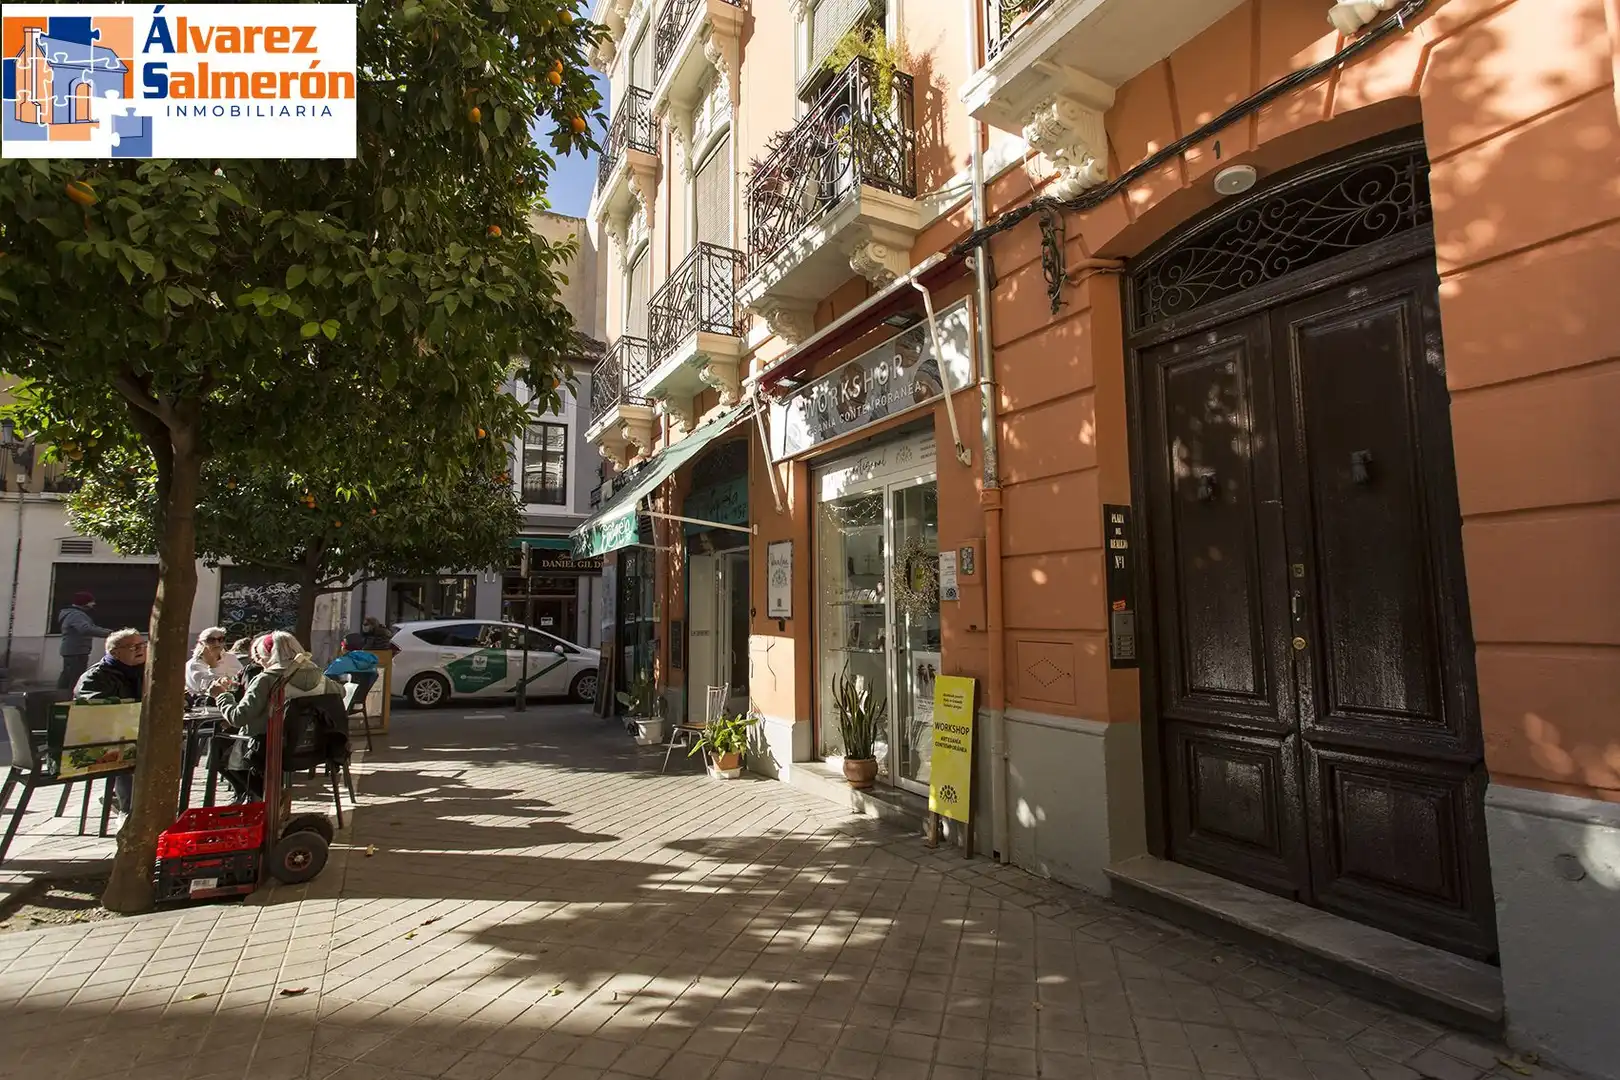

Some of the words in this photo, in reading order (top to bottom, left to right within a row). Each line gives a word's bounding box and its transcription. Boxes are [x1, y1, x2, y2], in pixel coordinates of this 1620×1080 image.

[1212, 140, 1221, 159] 1
[802, 354, 904, 419] WORKSHOP
[542, 560, 576, 568] DANIEL
[577, 560, 592, 568] GIL
[935, 722, 970, 736] WORKSHOP
